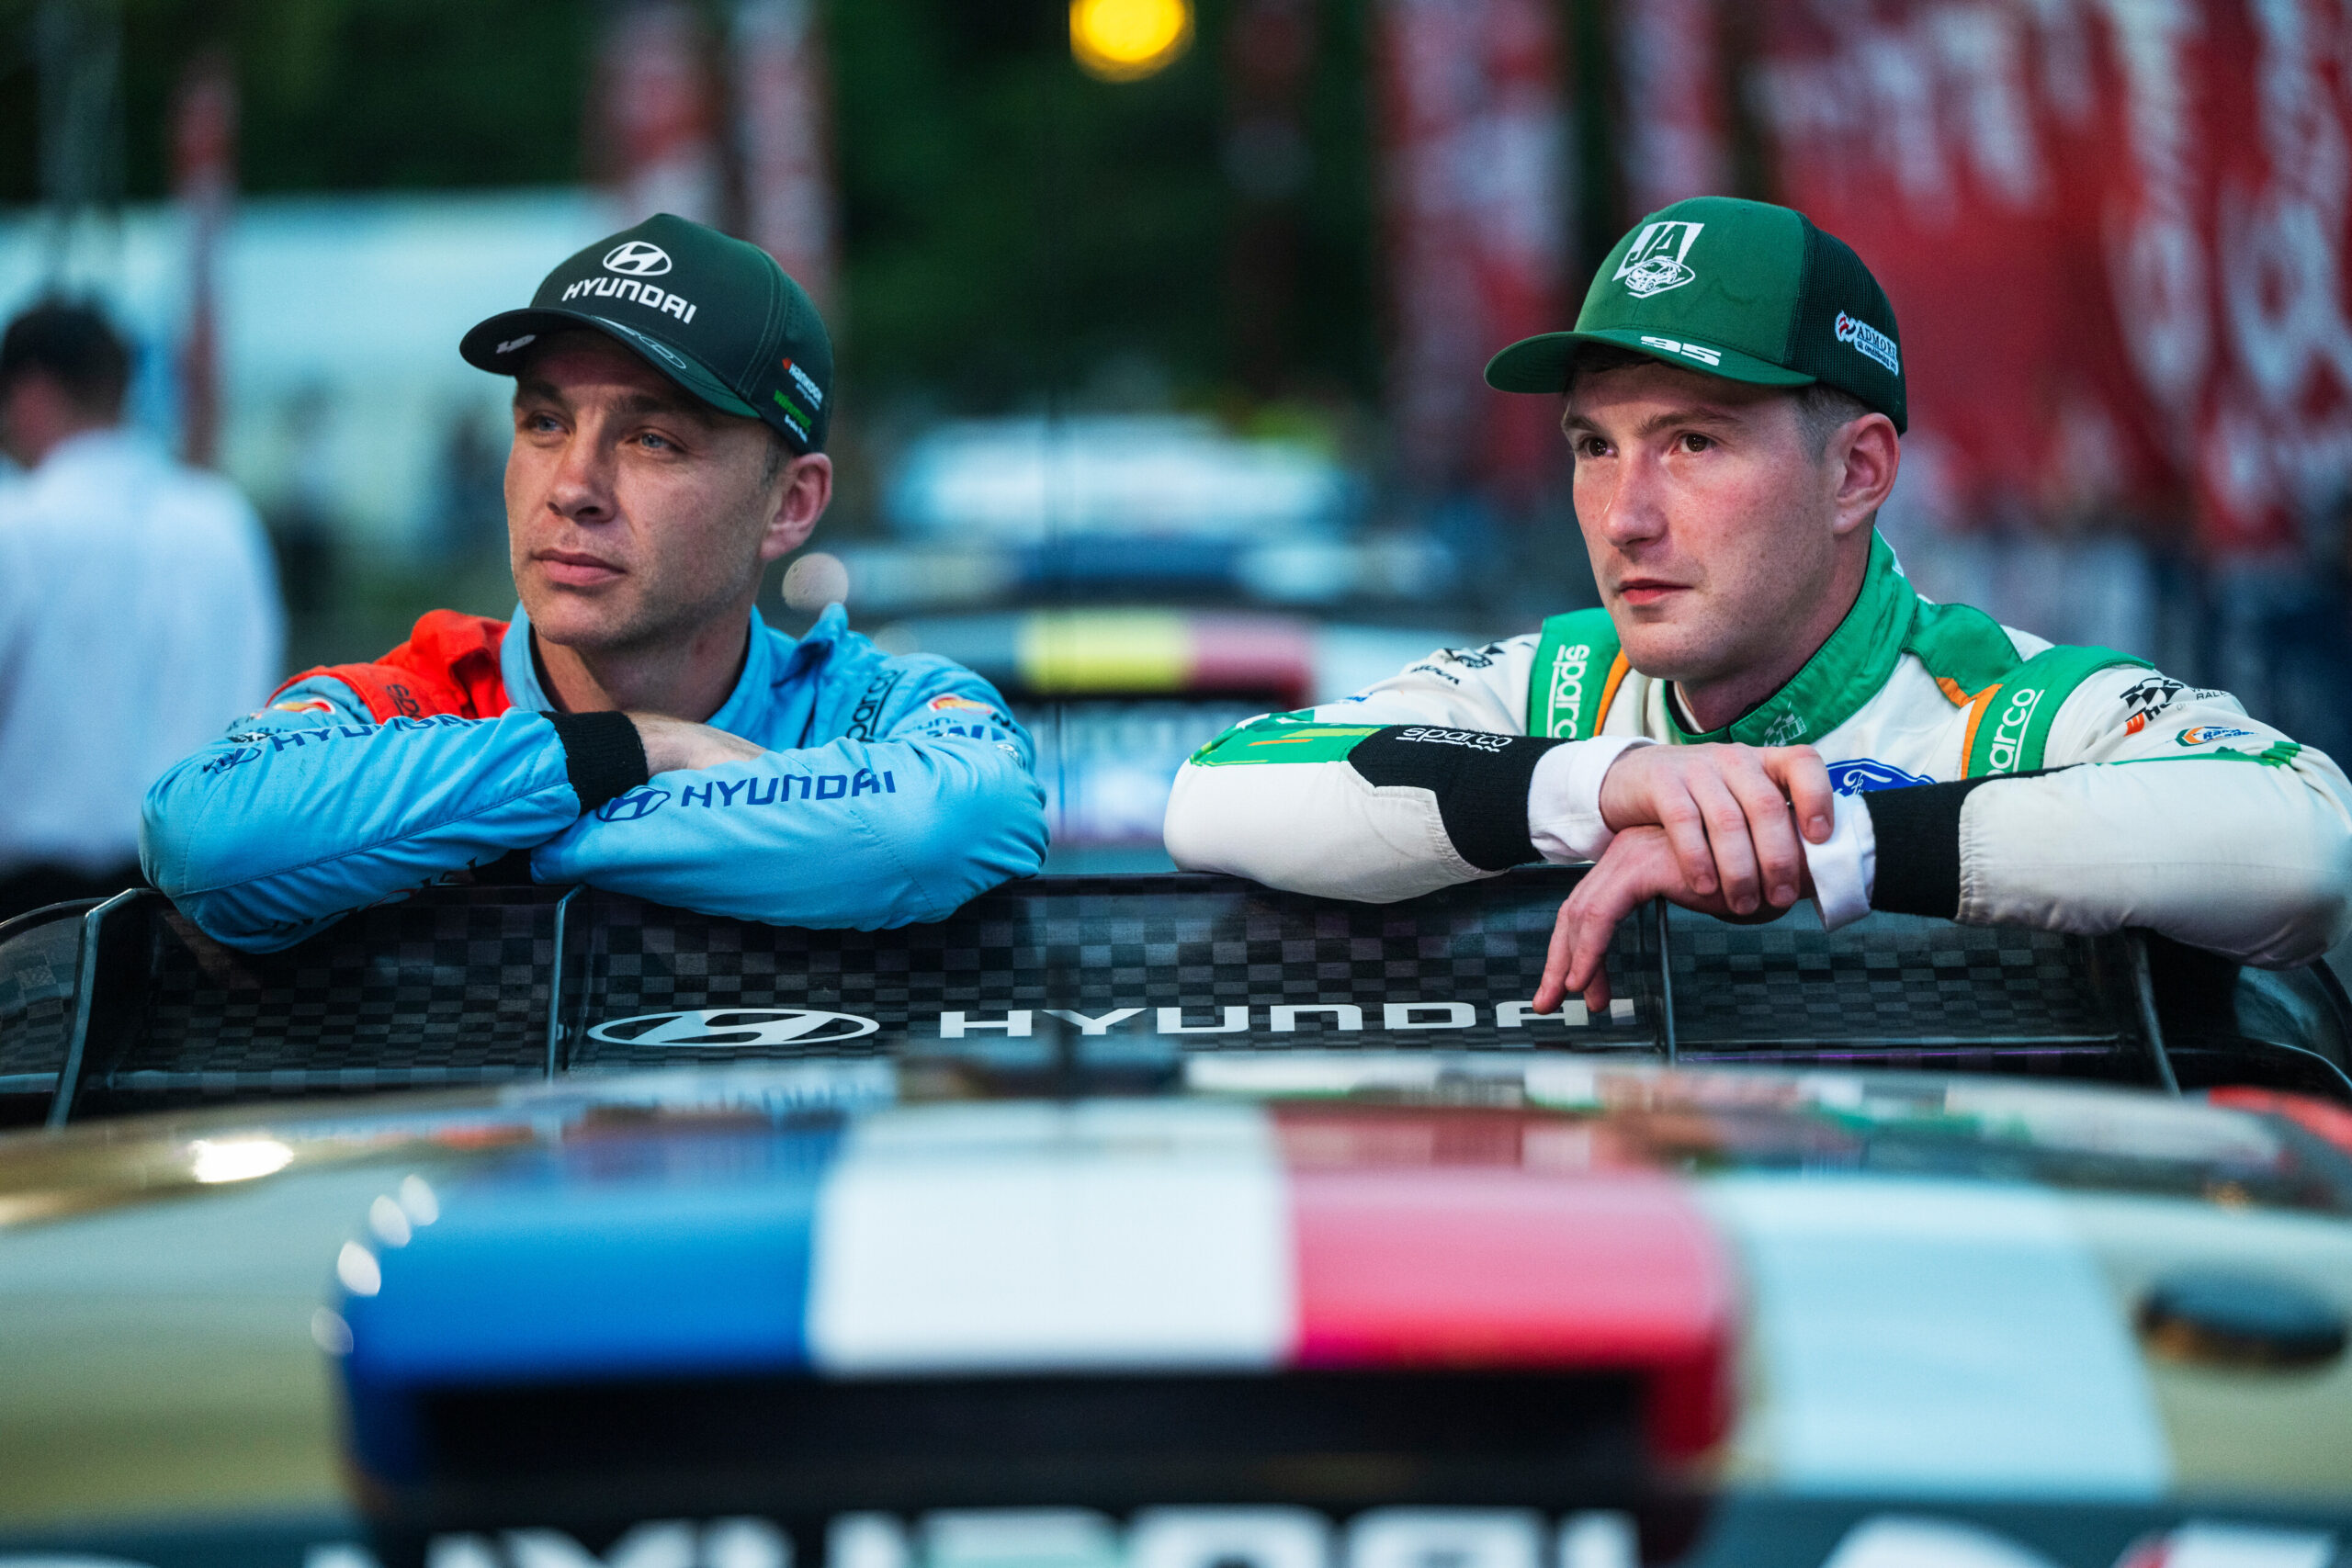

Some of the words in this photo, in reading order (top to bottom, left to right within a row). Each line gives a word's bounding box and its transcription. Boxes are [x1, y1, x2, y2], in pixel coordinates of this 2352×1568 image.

[561, 276, 697, 324] HYUNDAI
[1640, 335, 1722, 367] 95
[845, 669, 901, 742] parco
[1552, 644, 1590, 739] sparc
[1398, 728, 1513, 748] sparco
[1985, 688, 2037, 776] arco
[682, 767, 897, 808] HYUNDAI
[940, 998, 1636, 1039] HYUNDAI
